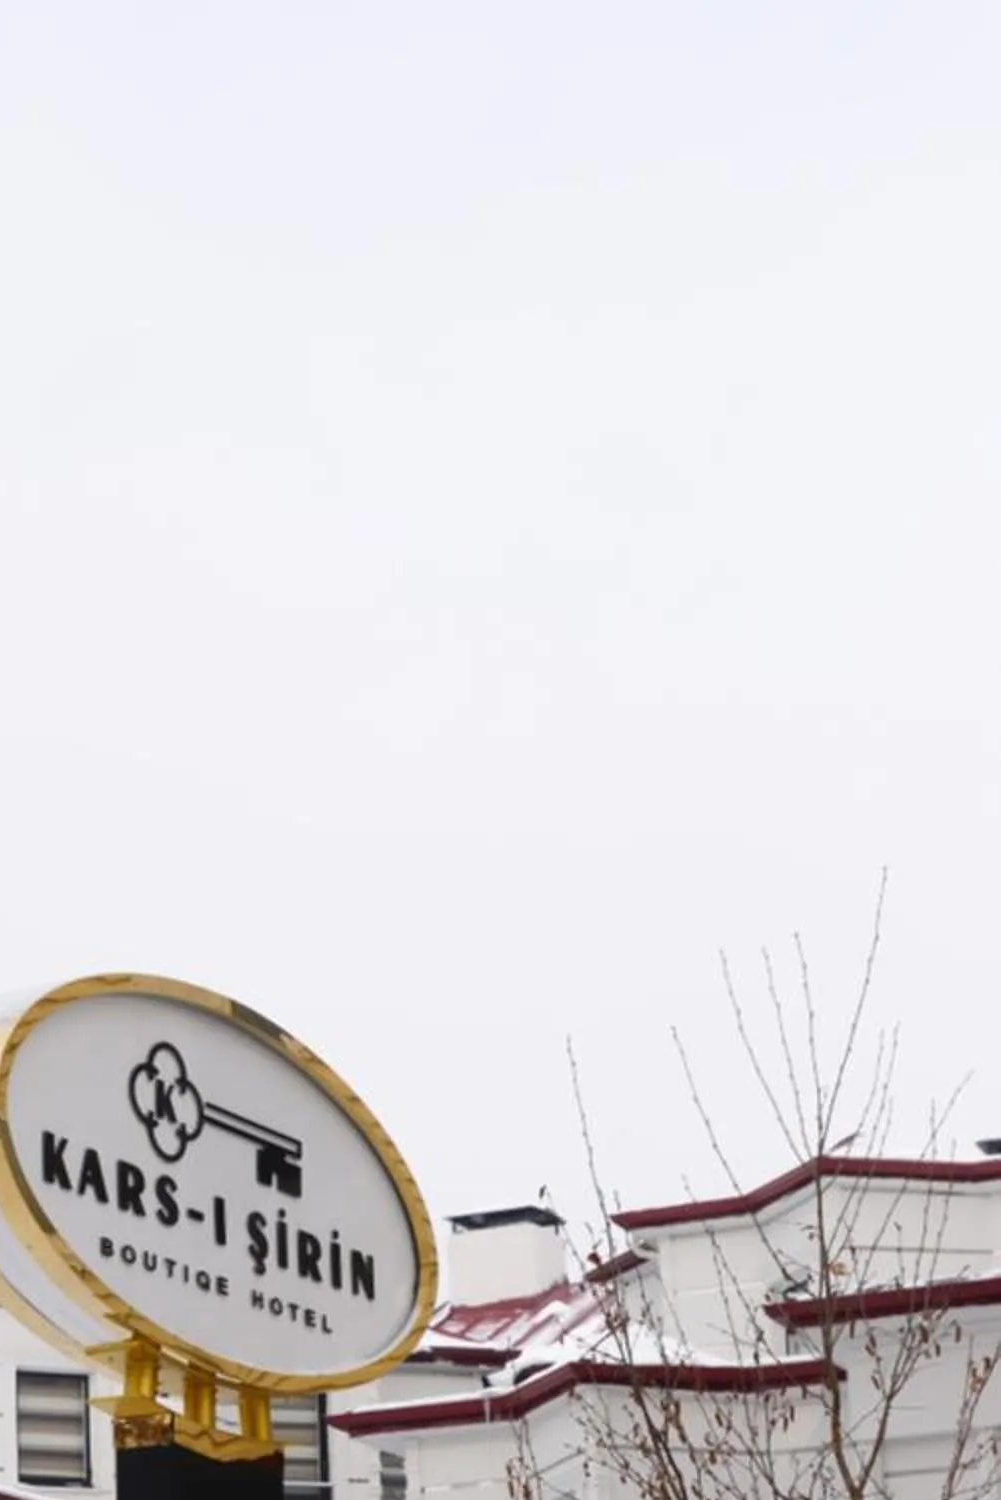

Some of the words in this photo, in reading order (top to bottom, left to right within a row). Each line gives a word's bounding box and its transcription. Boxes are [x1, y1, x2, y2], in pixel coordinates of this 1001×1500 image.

[155, 1079, 177, 1123] K
[41, 1130, 228, 1247] KARS-I
[245, 1208, 376, 1301] ŞİRİN
[100, 1236, 229, 1297] BOUTIQE
[250, 1290, 333, 1333] HOTEL
